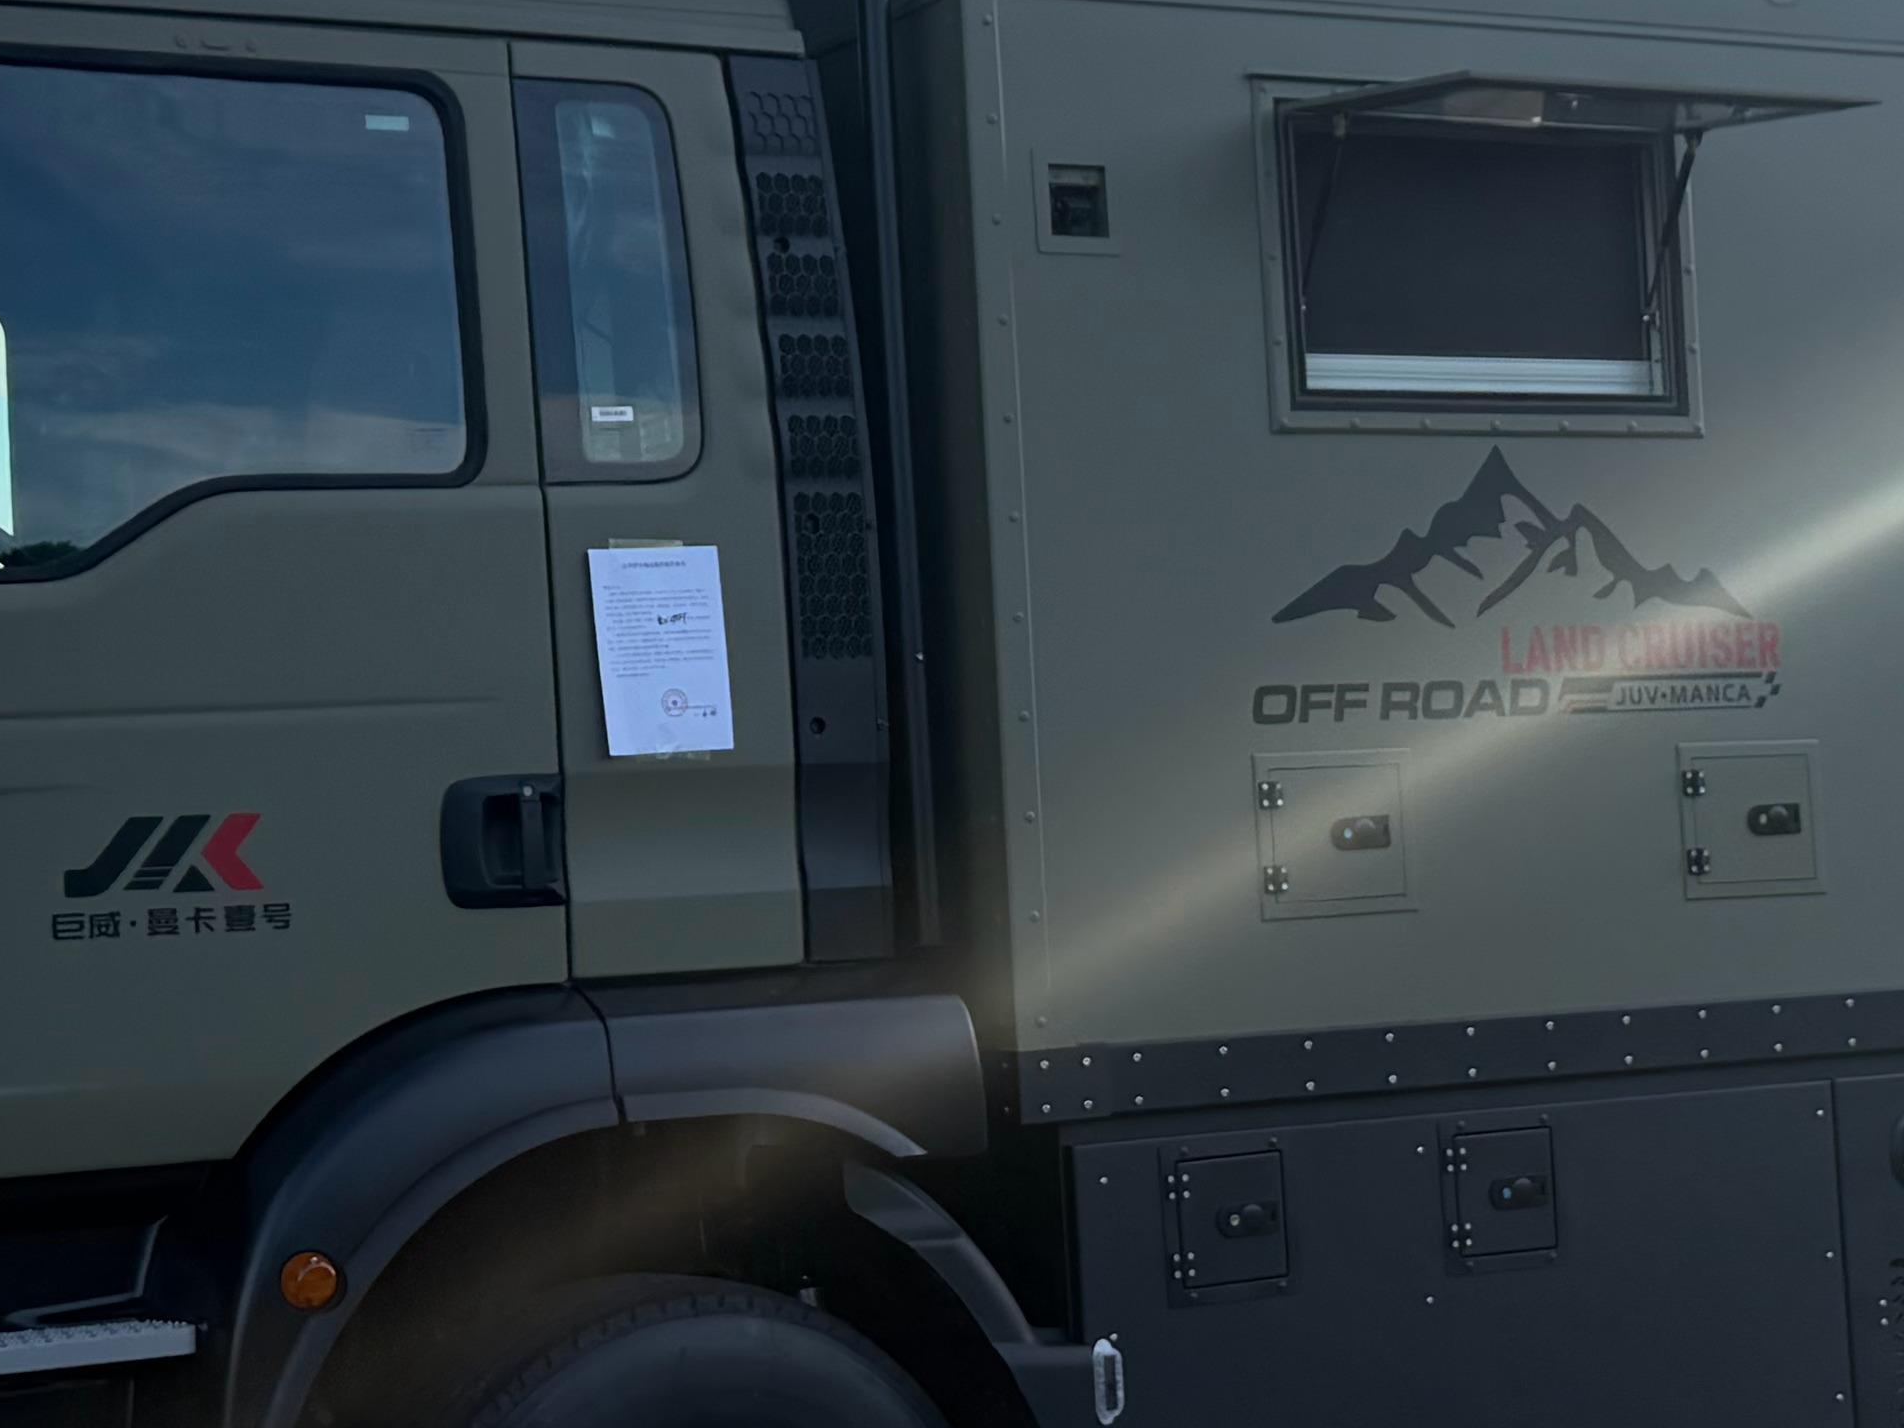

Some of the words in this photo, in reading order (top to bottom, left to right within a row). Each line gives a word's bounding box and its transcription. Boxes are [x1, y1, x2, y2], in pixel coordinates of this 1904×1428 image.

[1500, 625, 1606, 674] LAND
[1618, 621, 1782, 671] CRUISER
[1252, 682, 1370, 726] OFF
[1380, 678, 1551, 721] ROAD
